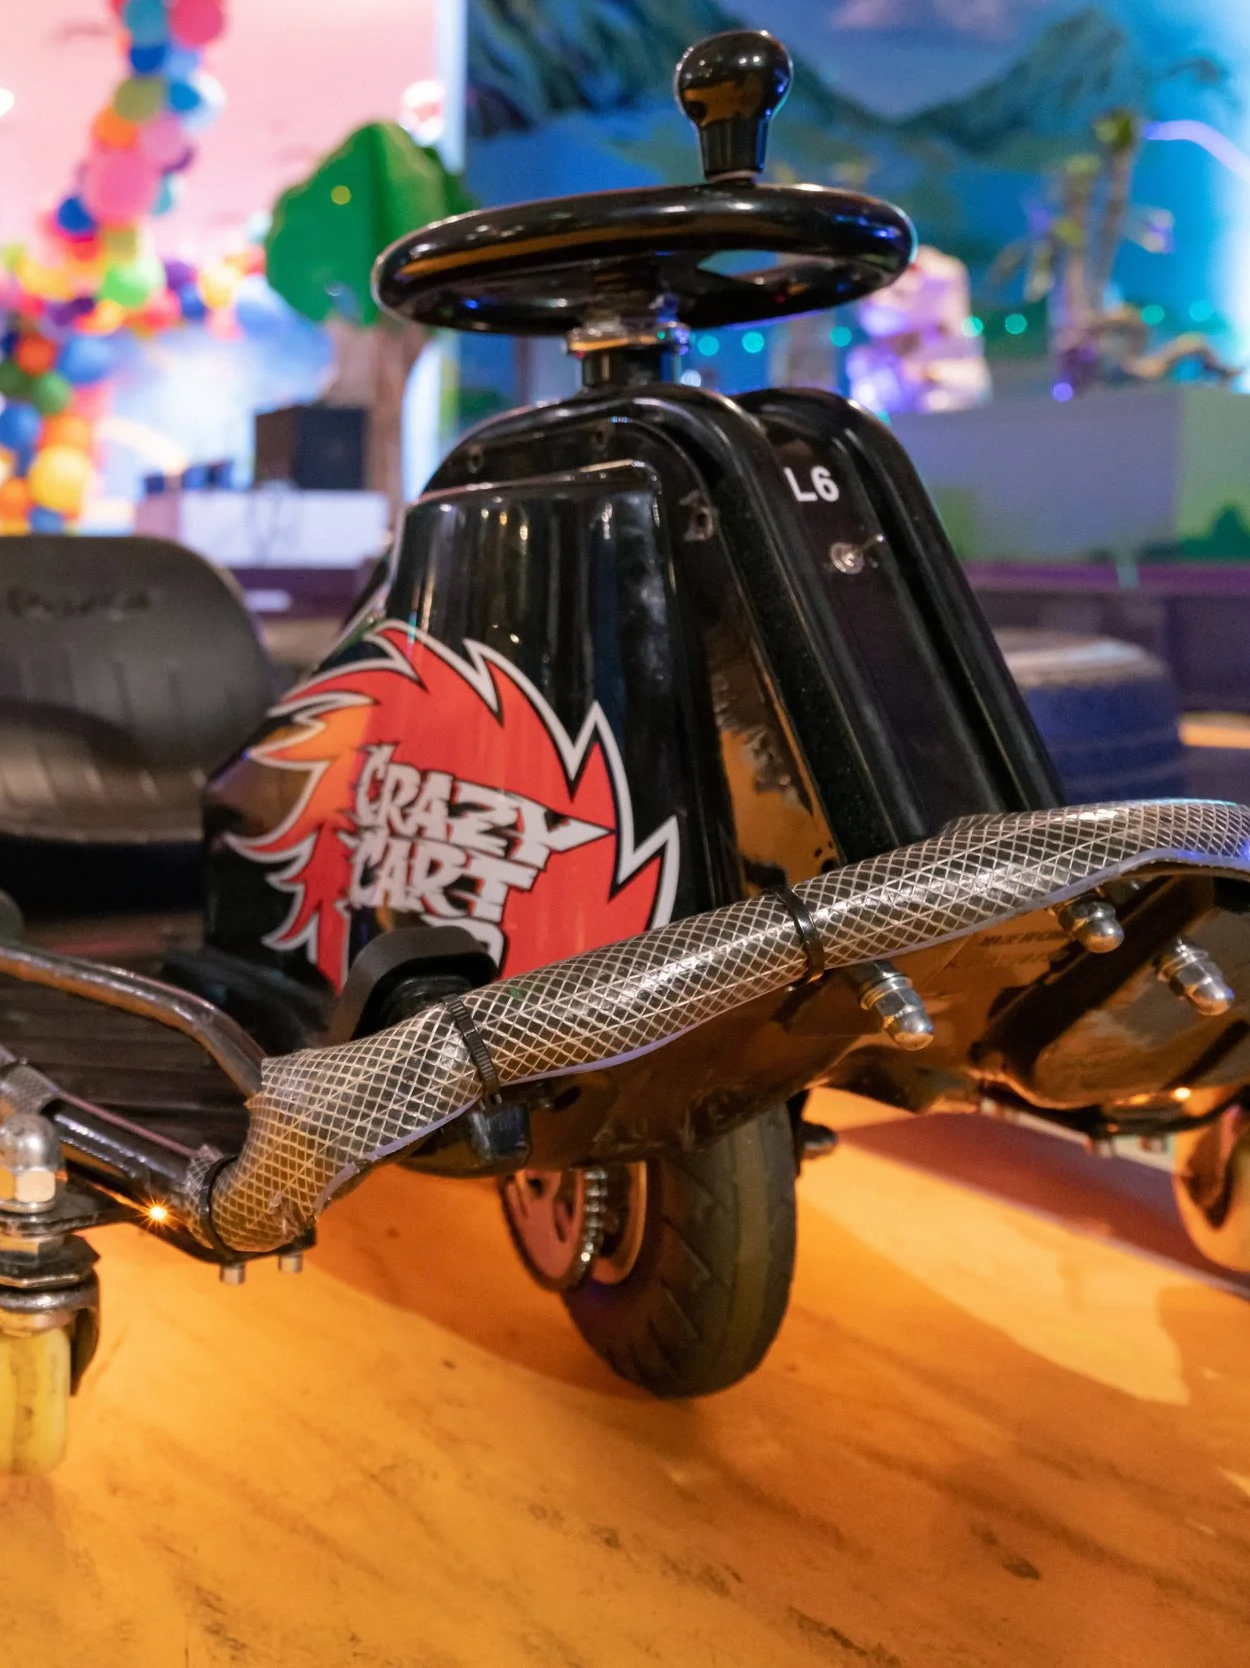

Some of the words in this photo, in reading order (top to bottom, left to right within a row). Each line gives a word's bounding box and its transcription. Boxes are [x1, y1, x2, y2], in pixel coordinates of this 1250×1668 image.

[783, 465, 840, 502] L6
[355, 742, 615, 869] CRAZY
[344, 827, 538, 922] CART
